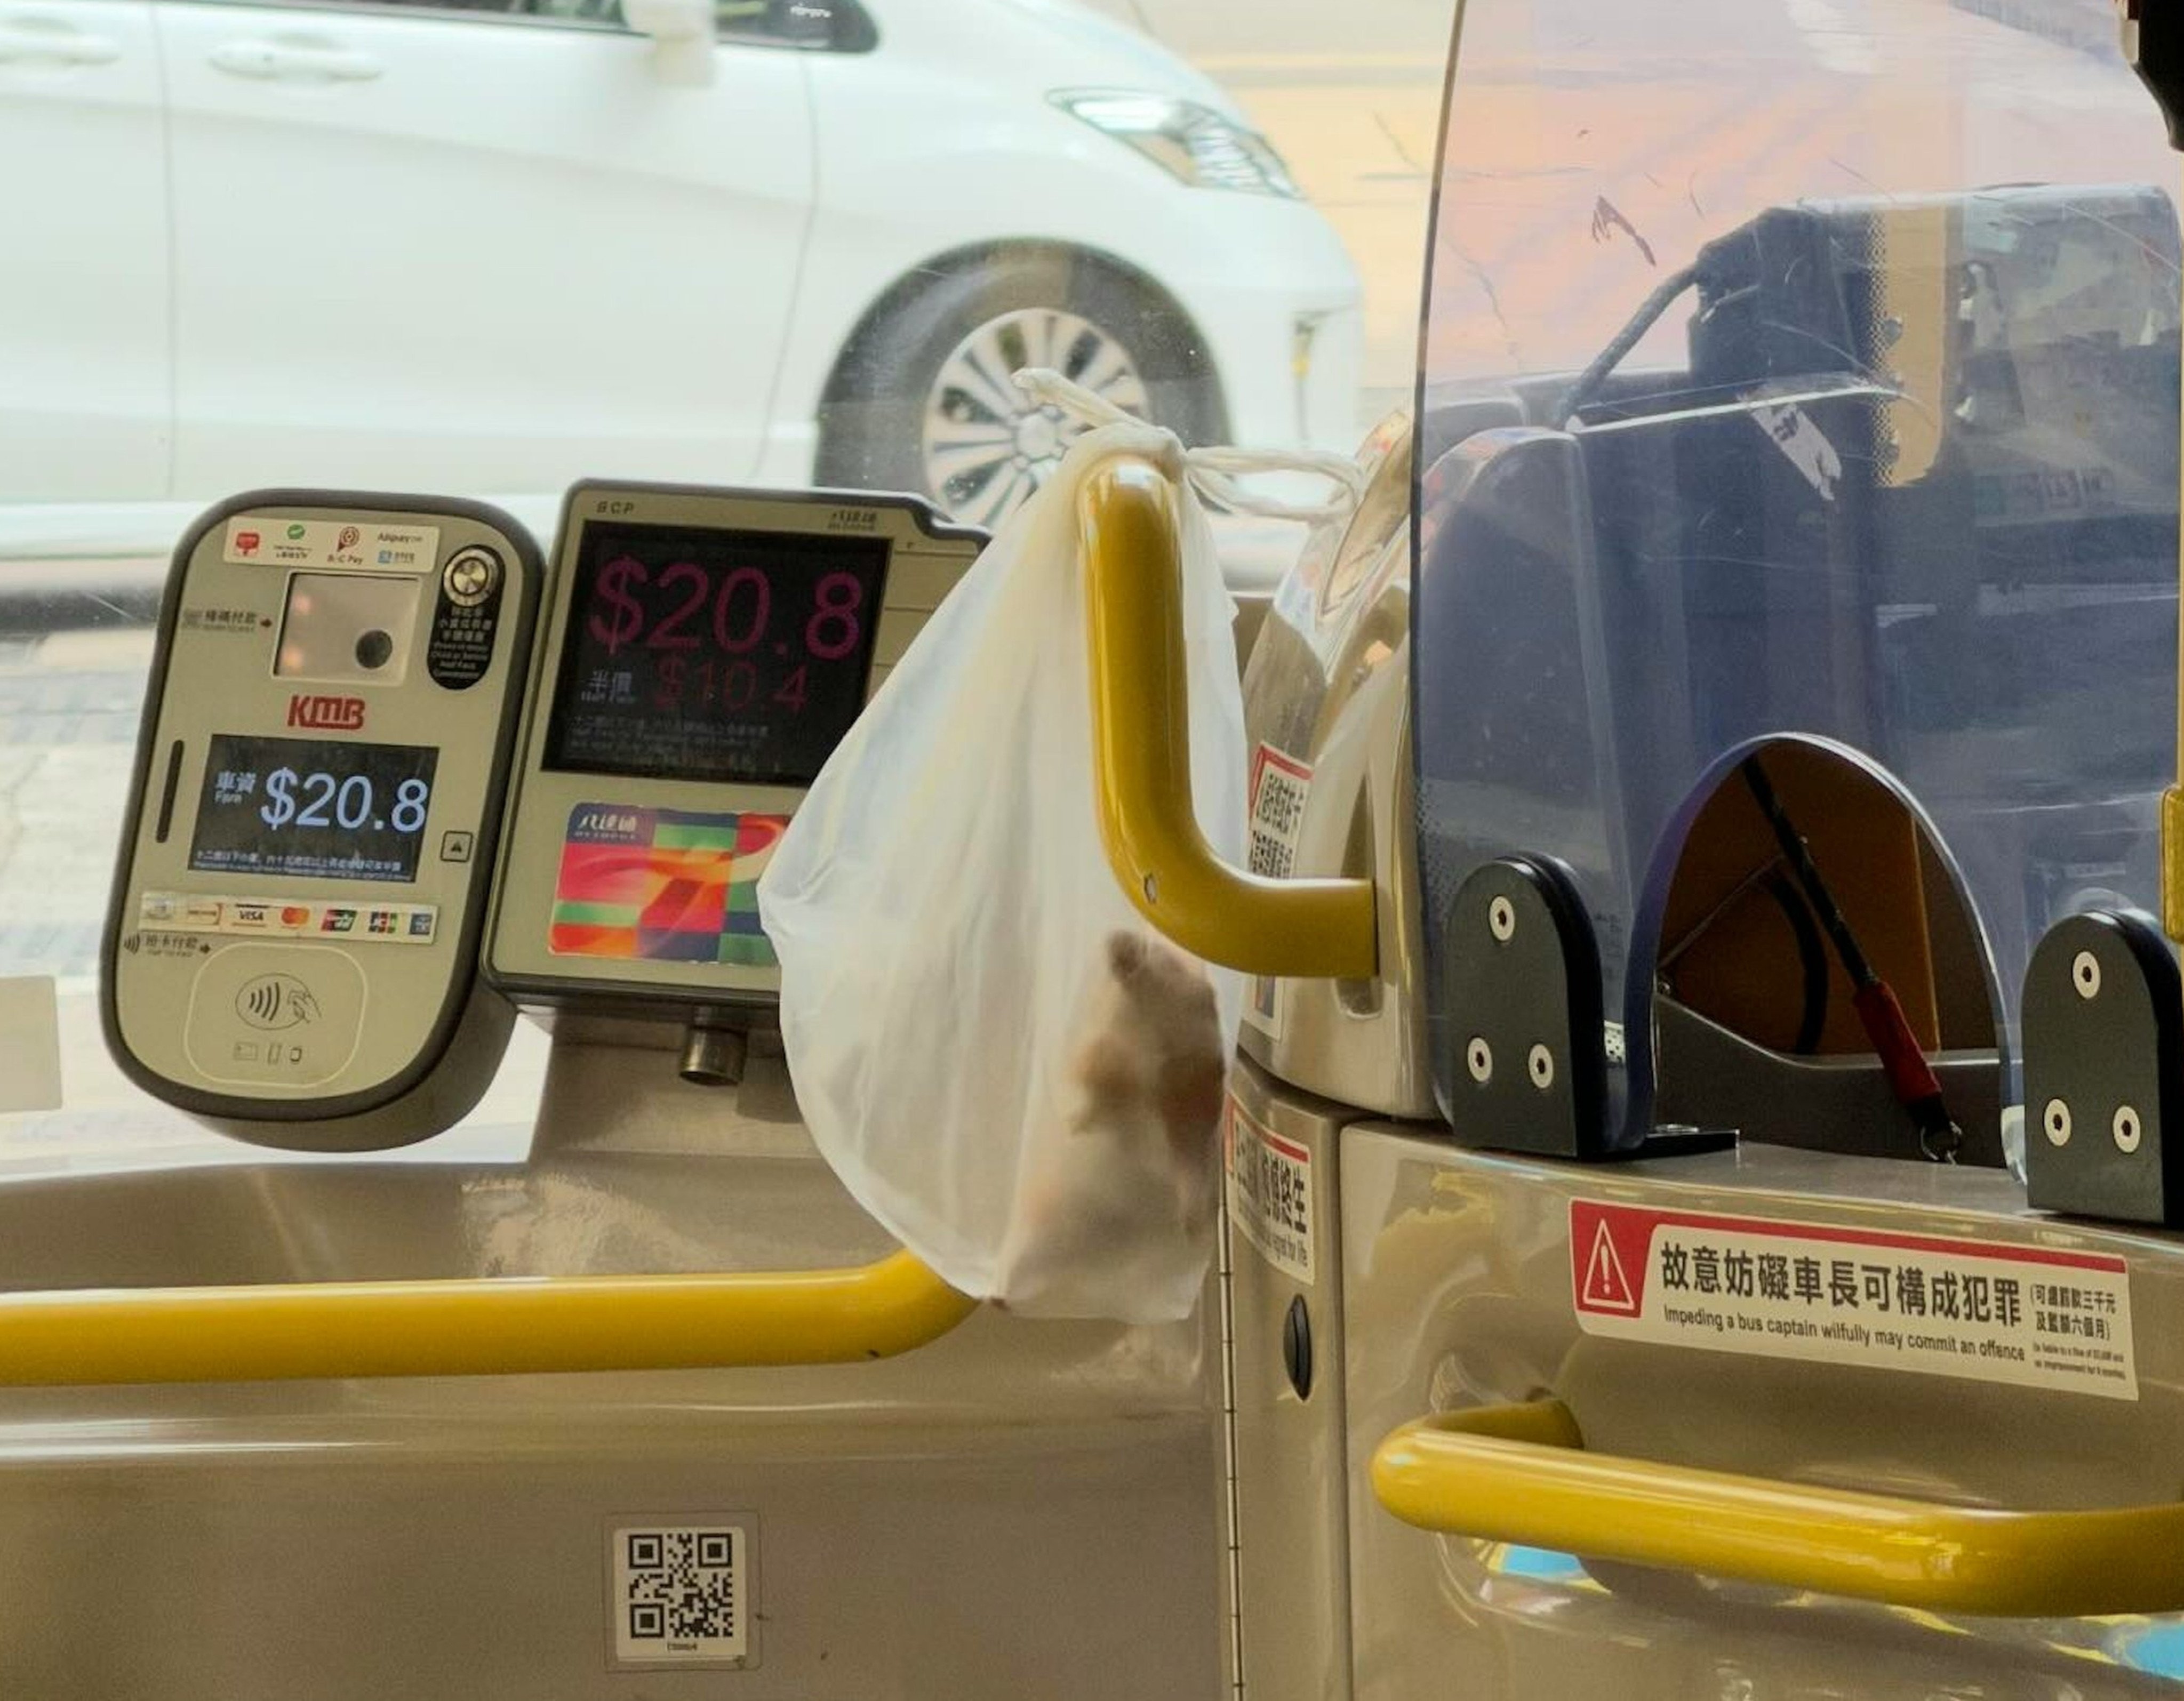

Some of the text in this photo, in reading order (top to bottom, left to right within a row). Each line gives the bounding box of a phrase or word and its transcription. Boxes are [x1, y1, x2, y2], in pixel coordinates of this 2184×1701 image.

[588, 553, 863, 660] $20.8
[287, 695, 366, 730] KMB
[654, 657, 809, 713] $10.4
[217, 771, 257, 794] 車資
[261, 767, 428, 832] $20.8
[238, 909, 265, 922] VISA
[1661, 1242, 2021, 1327] 故意妨礙車長可構成犯罪
[1664, 1304, 1724, 1331] Impeding
[1727, 1316, 1734, 1328] a
[1737, 1312, 1763, 1331] bus
[1767, 1320, 1818, 1337] captain
[1821, 1320, 1870, 1347] wilfully
[1875, 1331, 1903, 1350] may
[1907, 1335, 1957, 1352] commit
[1961, 1339, 1975, 1354] an
[1979, 1339, 2025, 1361] offence
